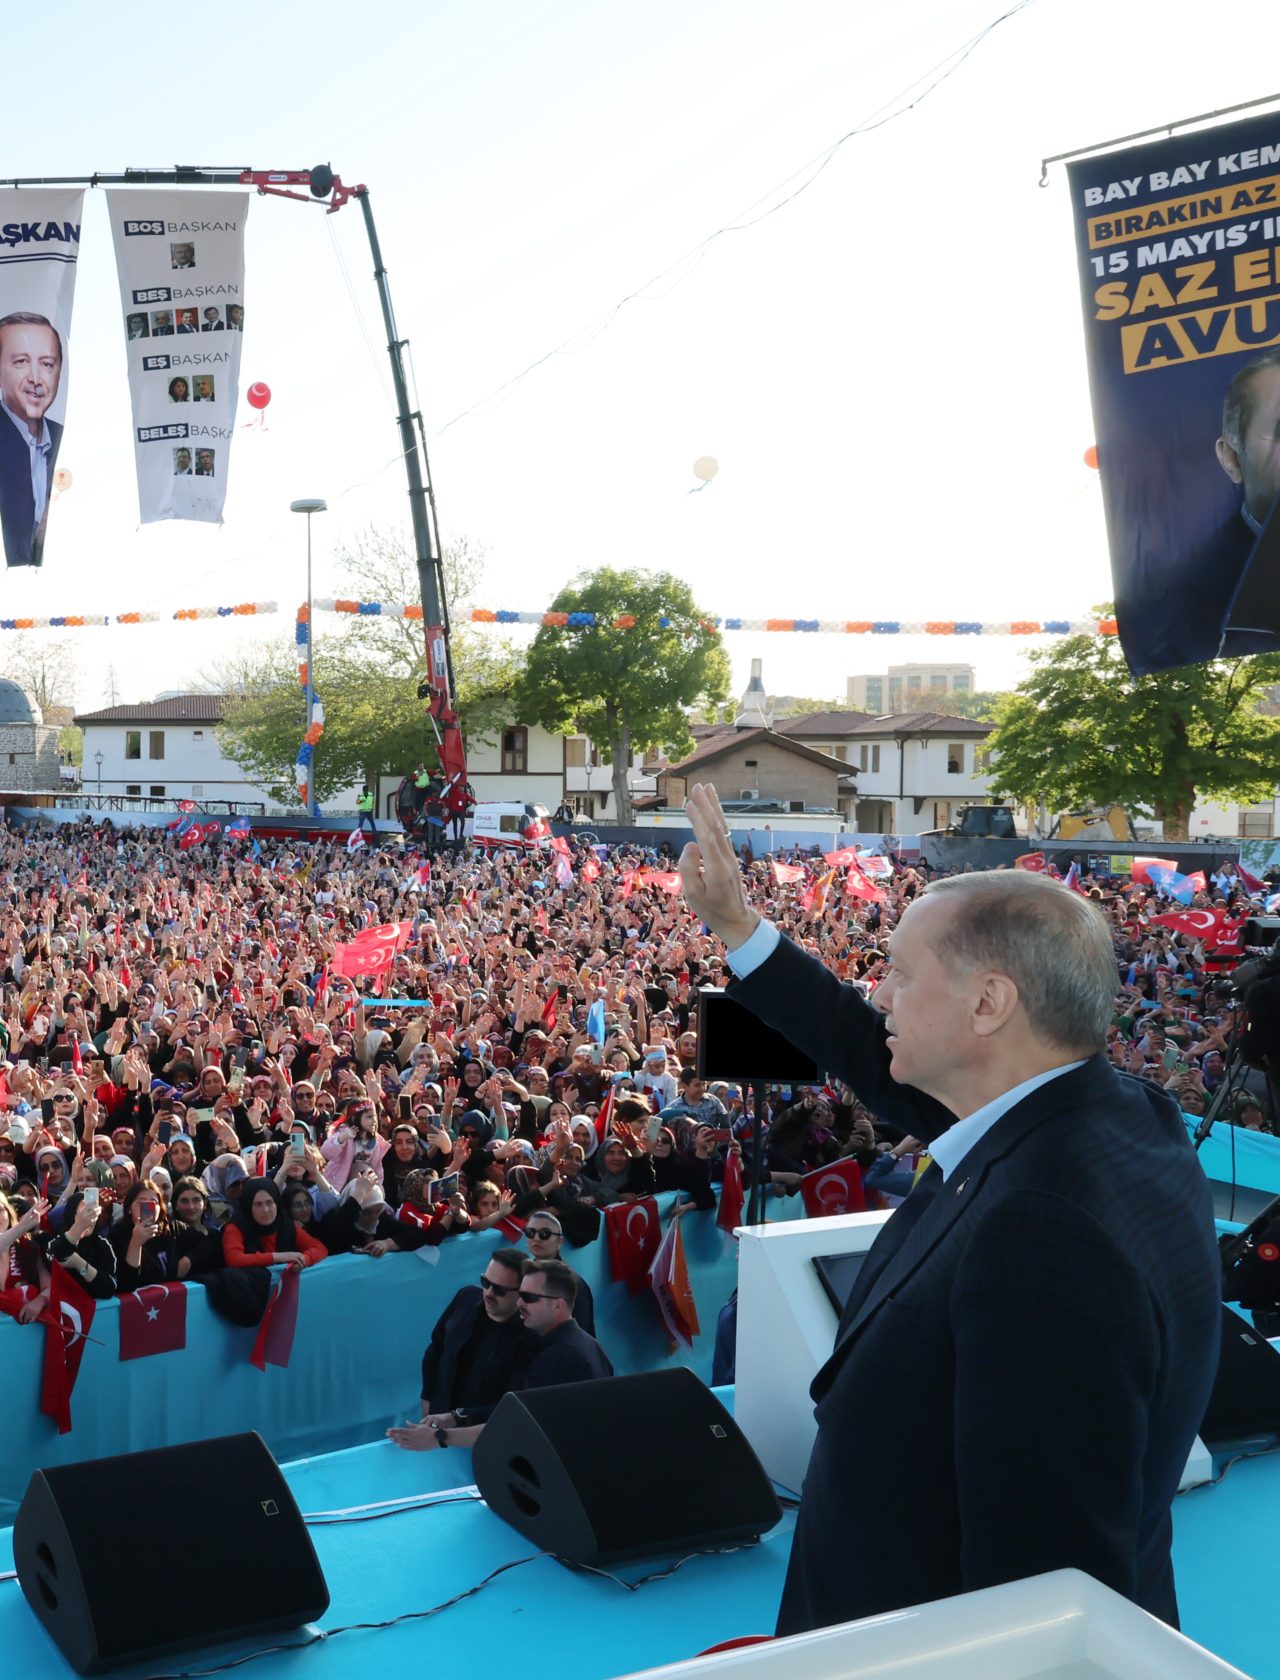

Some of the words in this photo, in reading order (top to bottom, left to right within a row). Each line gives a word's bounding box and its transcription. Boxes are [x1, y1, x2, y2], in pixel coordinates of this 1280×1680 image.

[1084, 176, 1143, 207] BAY
[1149, 160, 1211, 192] BAY
[1094, 195, 1222, 242] BIRAKIN
[1231, 183, 1277, 211] AZ
[127, 222, 163, 234] BOŞ
[167, 221, 237, 233] BAŞKAN
[1091, 250, 1129, 277] 15
[136, 289, 168, 302] BEŞ
[172, 285, 239, 299] BAŞKAN
[1094, 260, 1218, 321] SAZ
[147, 357, 167, 369] EŞ
[140, 425, 186, 441] BELEŞ
